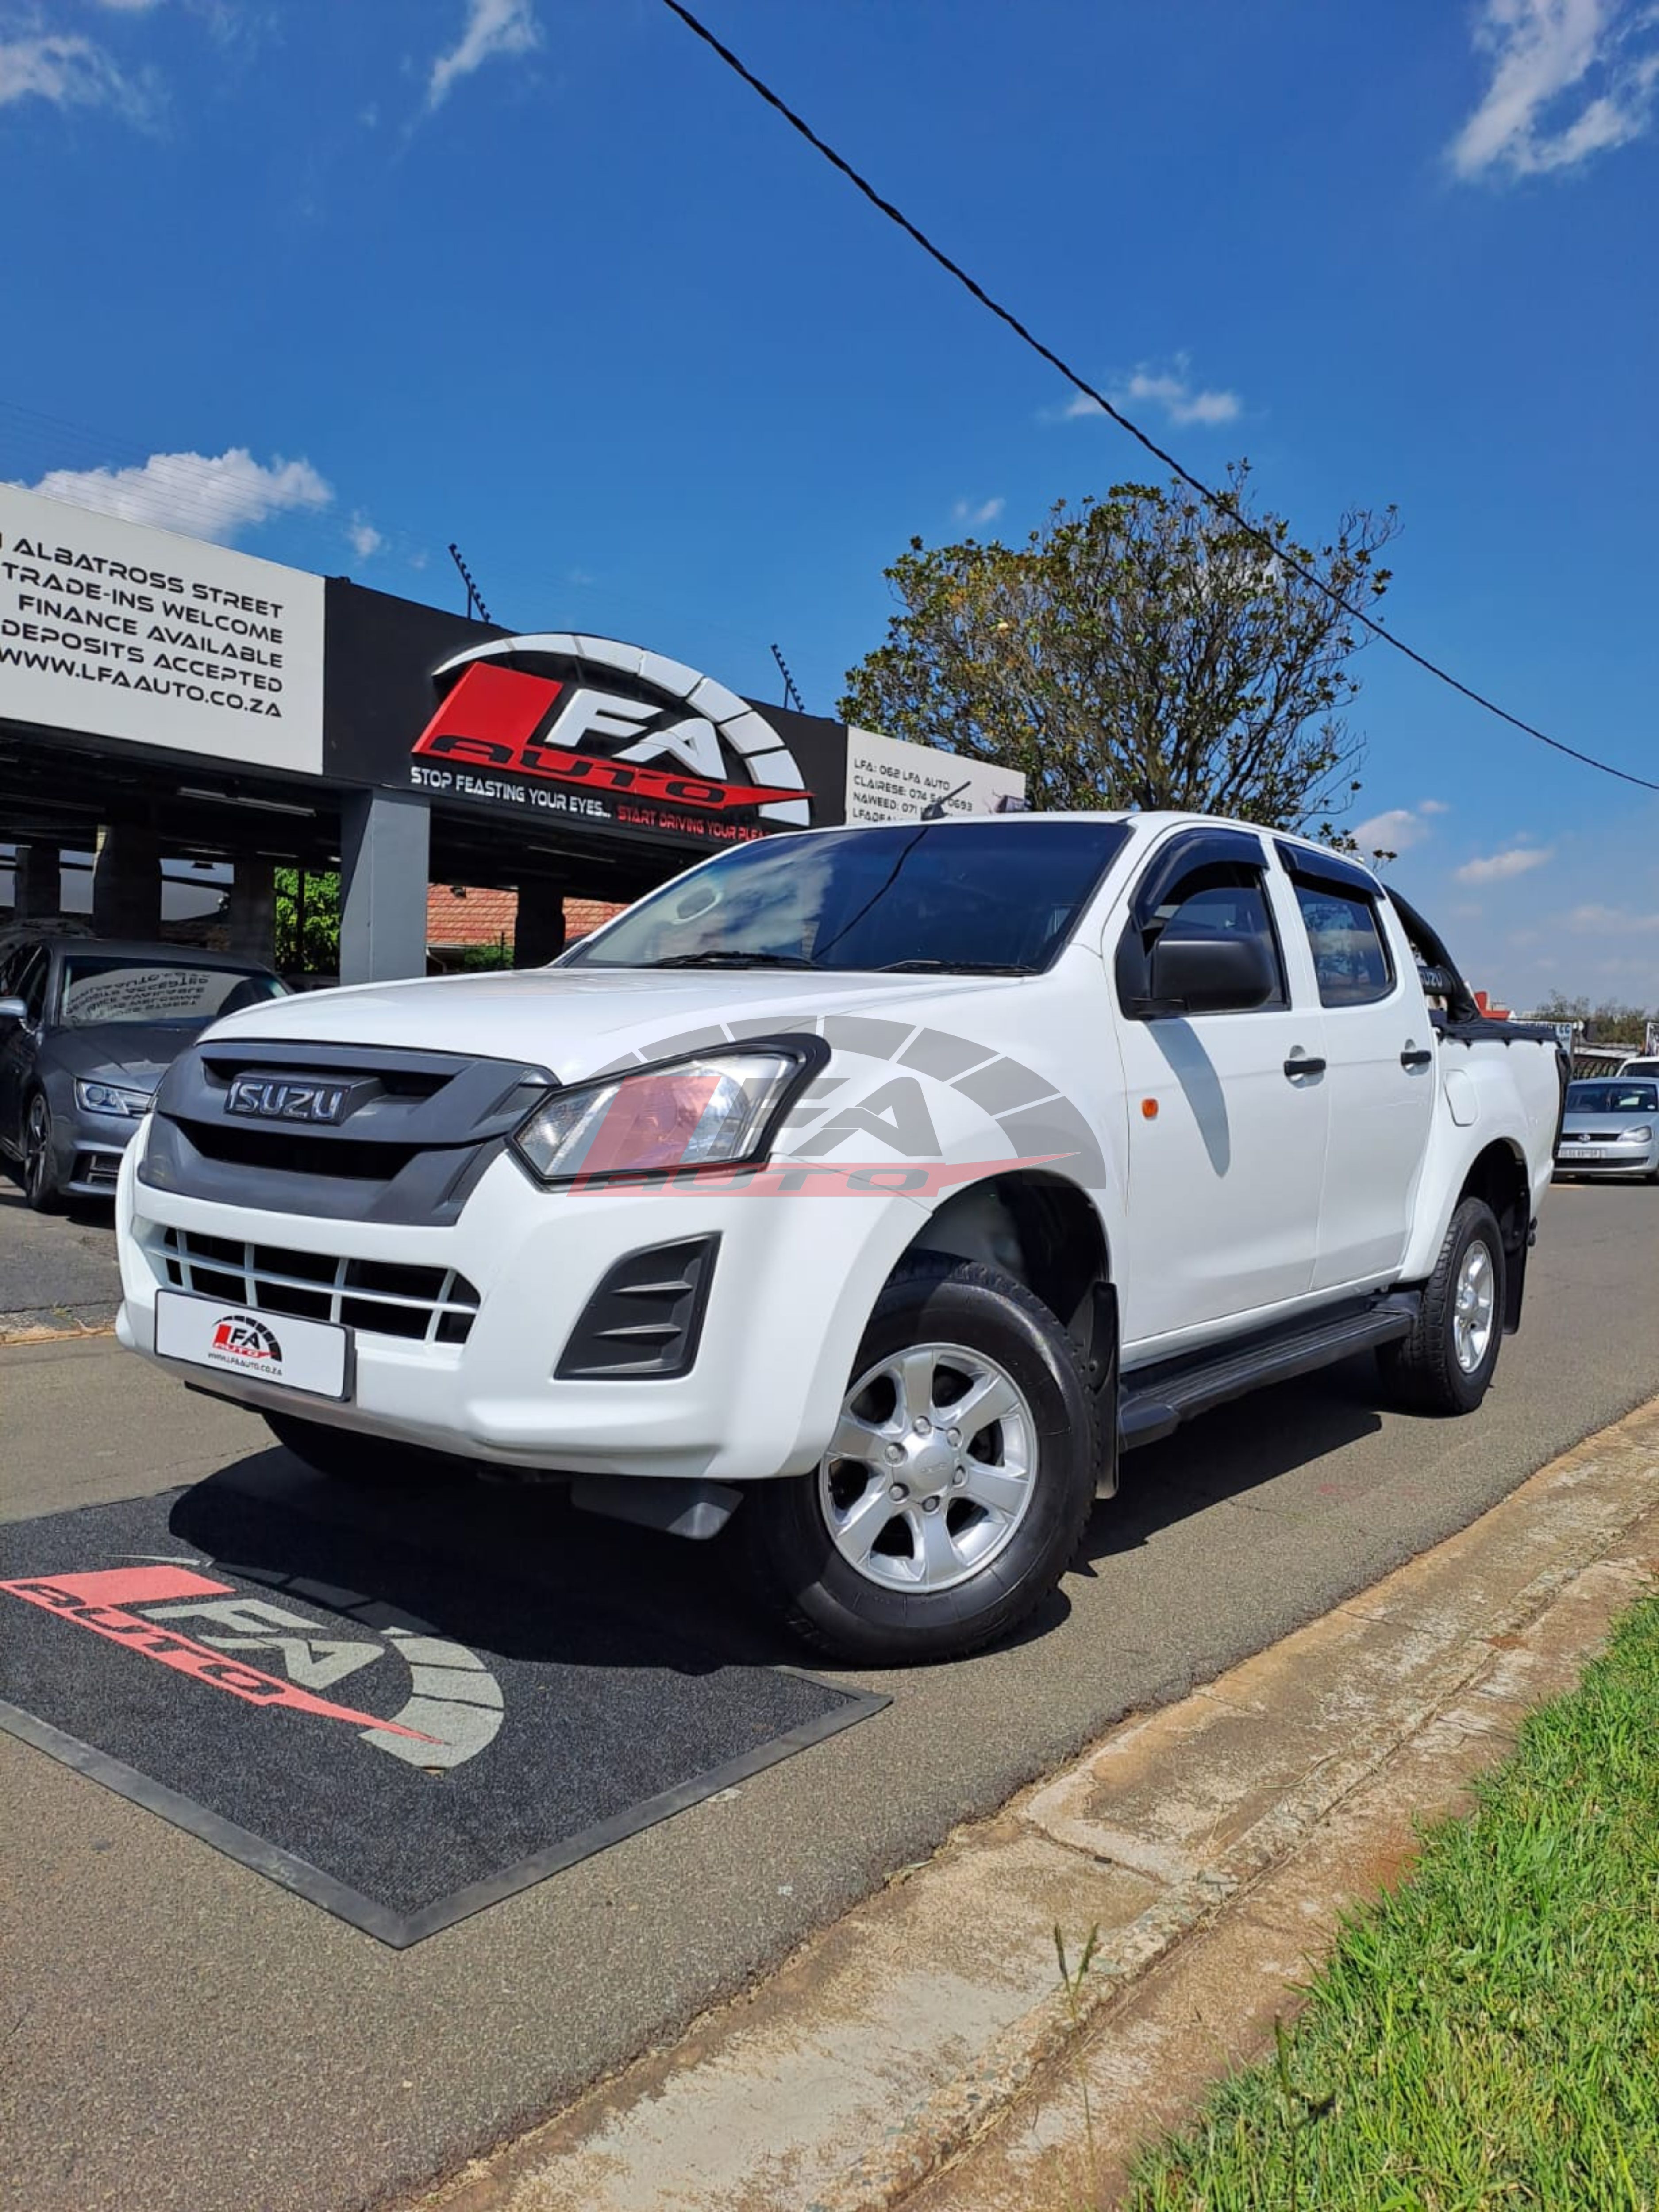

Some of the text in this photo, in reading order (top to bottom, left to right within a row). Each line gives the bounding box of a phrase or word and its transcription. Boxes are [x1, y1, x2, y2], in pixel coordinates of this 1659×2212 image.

[1, 562, 283, 644] TRADE-INS WELCOME
[13, 538, 184, 594] ALBATROSS
[192, 583, 283, 618] STREET
[1, 619, 283, 692] DEPOSITS ACCEPTED
[19, 594, 283, 668] FINANCE AVAILABLE
[0, 648, 282, 718] WWW.LFAAUTO.CO.ZA
[410, 766, 452, 789] STOP
[456, 774, 525, 803] FEASTING
[528, 788, 566, 811] YOUR
[617, 805, 656, 825] START
[659, 812, 704, 834] DRIVING
[708, 820, 736, 839] YOUR
[429, 735, 727, 803] AUTO
[854, 758, 877, 772] LFA:
[903, 770, 921, 784] LFA
[924, 777, 951, 791] AUTO
[854, 775, 906, 796] CLAIRESE:
[227, 1081, 343, 1120] ISUZU
